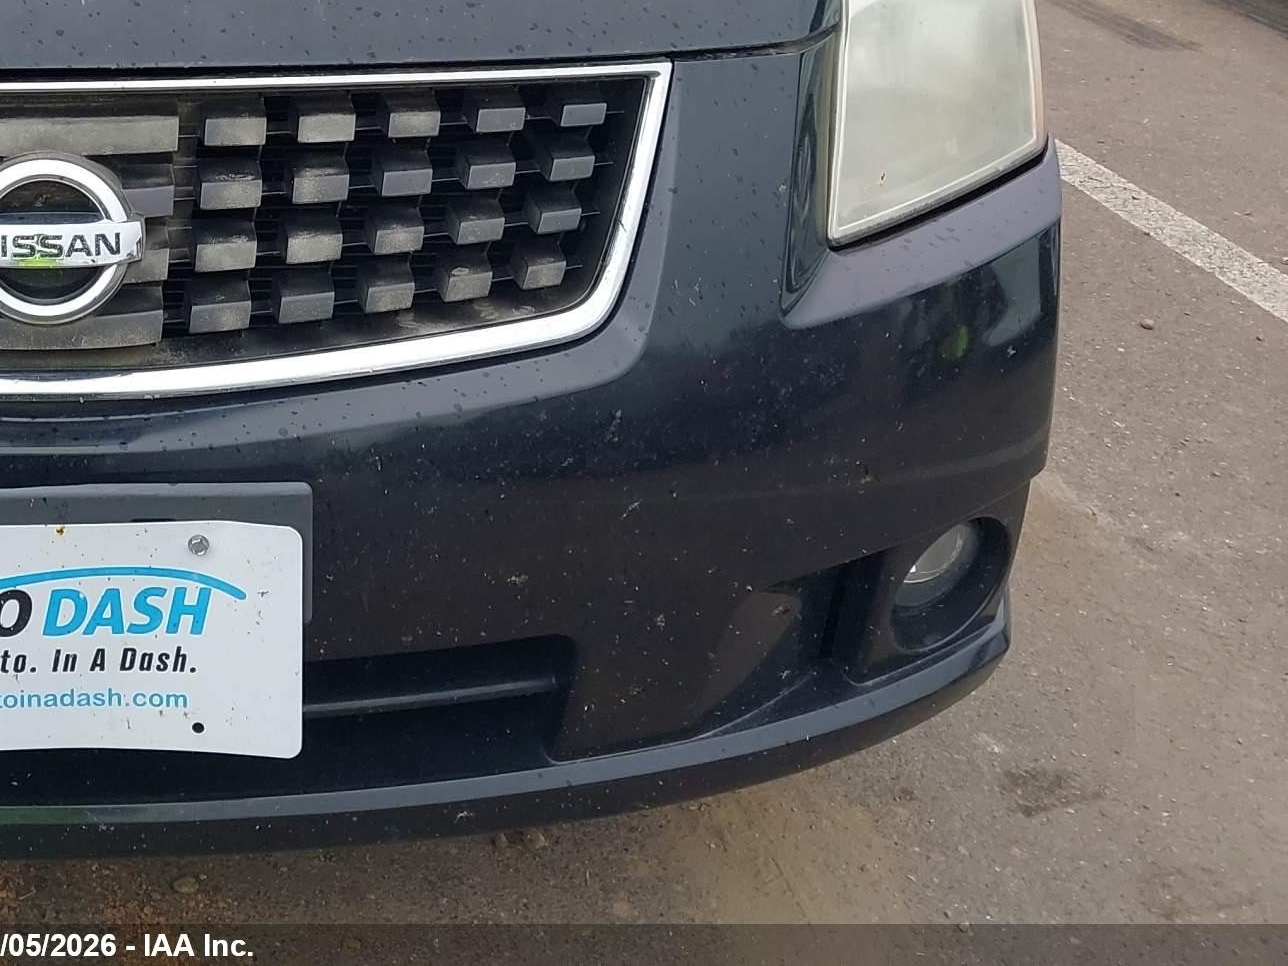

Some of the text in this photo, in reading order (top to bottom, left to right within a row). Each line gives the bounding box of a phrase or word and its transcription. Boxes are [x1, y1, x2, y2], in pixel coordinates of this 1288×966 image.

[42, 586, 213, 636] DASH
[52, 648, 78, 673] In
[89, 647, 106, 672] A
[120, 646, 198, 674] Dash.
